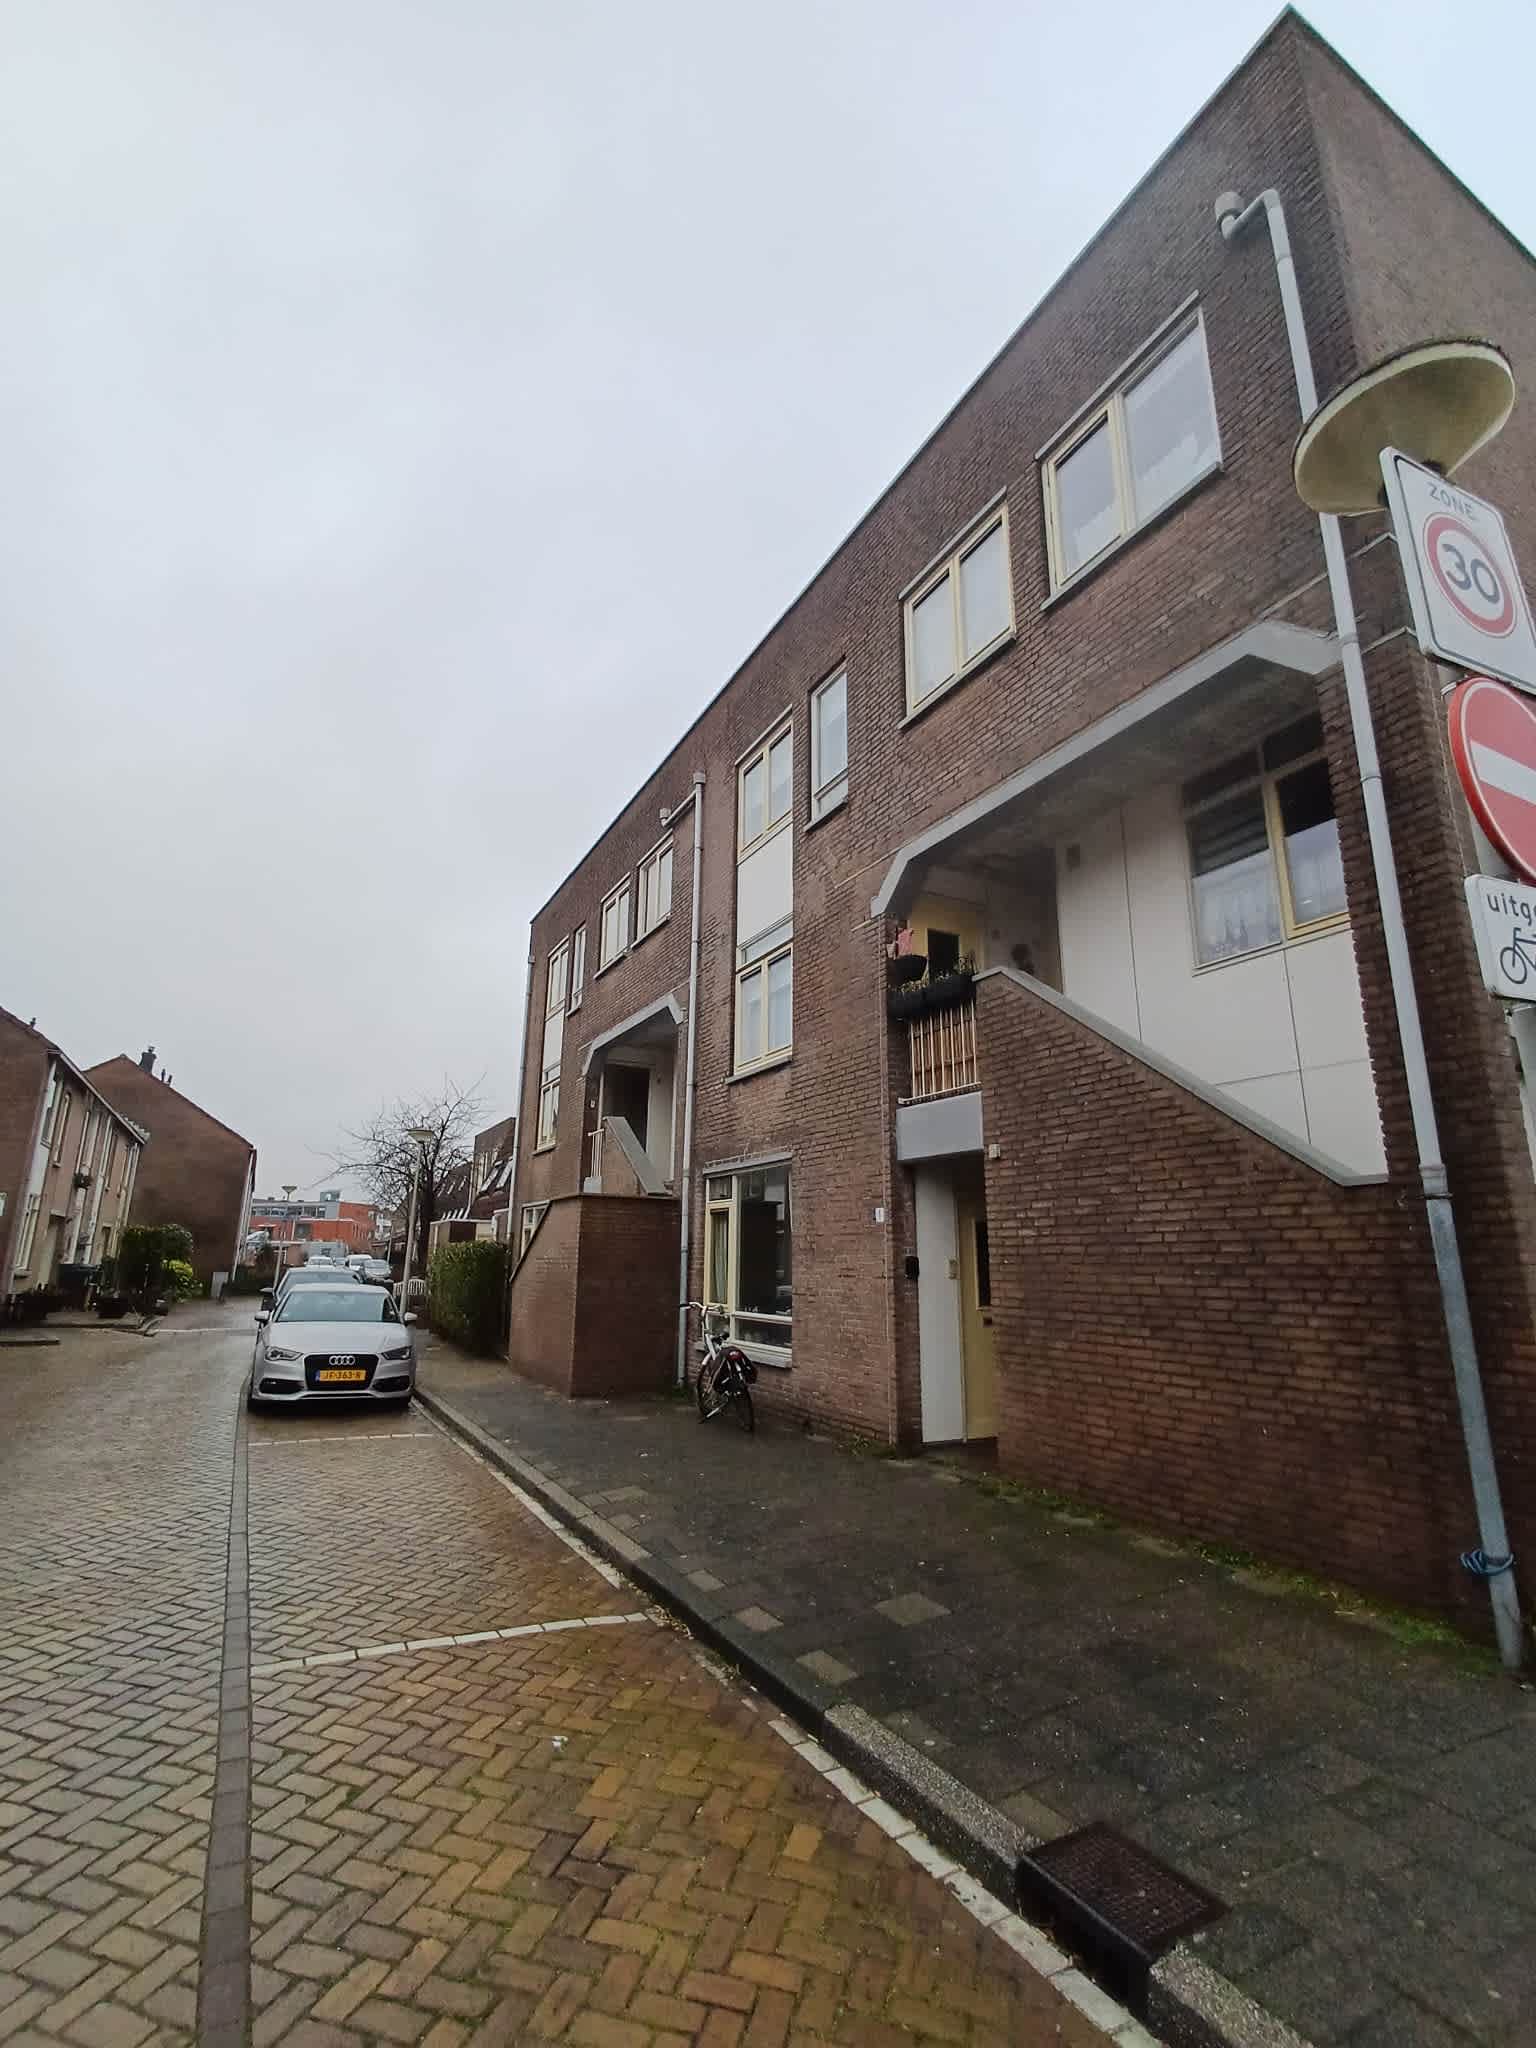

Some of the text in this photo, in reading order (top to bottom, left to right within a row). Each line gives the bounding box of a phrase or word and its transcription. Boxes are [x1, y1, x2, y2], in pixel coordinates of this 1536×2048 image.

[1427, 482, 1475, 519] ZONE
[1441, 543, 1500, 604] 30
[1486, 892, 1536, 926] uitg
